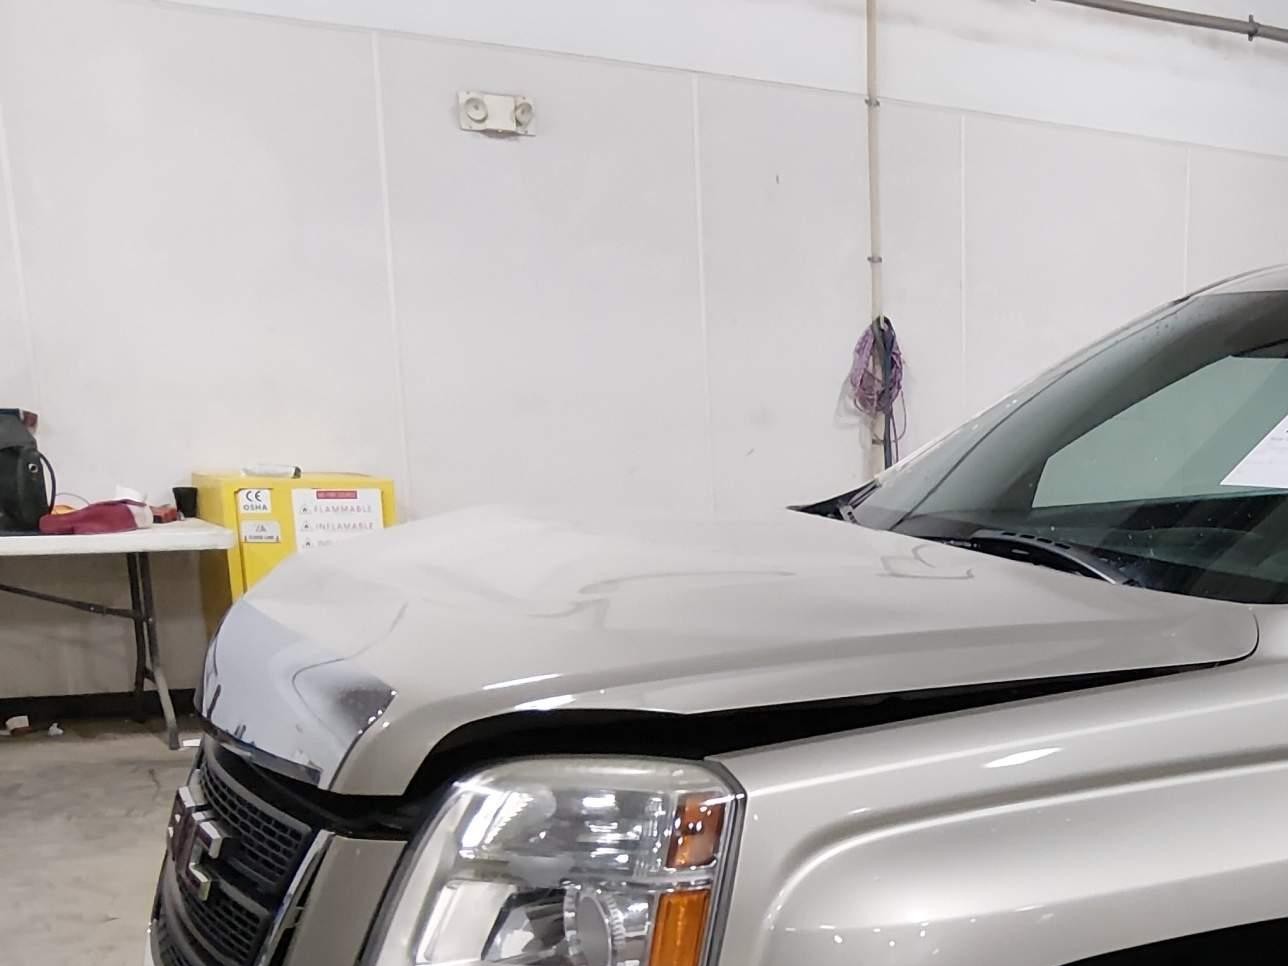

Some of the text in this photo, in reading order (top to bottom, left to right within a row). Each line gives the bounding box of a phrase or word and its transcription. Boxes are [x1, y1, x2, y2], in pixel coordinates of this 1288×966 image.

[245, 490, 263, 502] CE
[243, 503, 268, 511] OSHA
[313, 505, 373, 513] FLAMMABLE
[315, 522, 374, 530] INFLAMABLE
